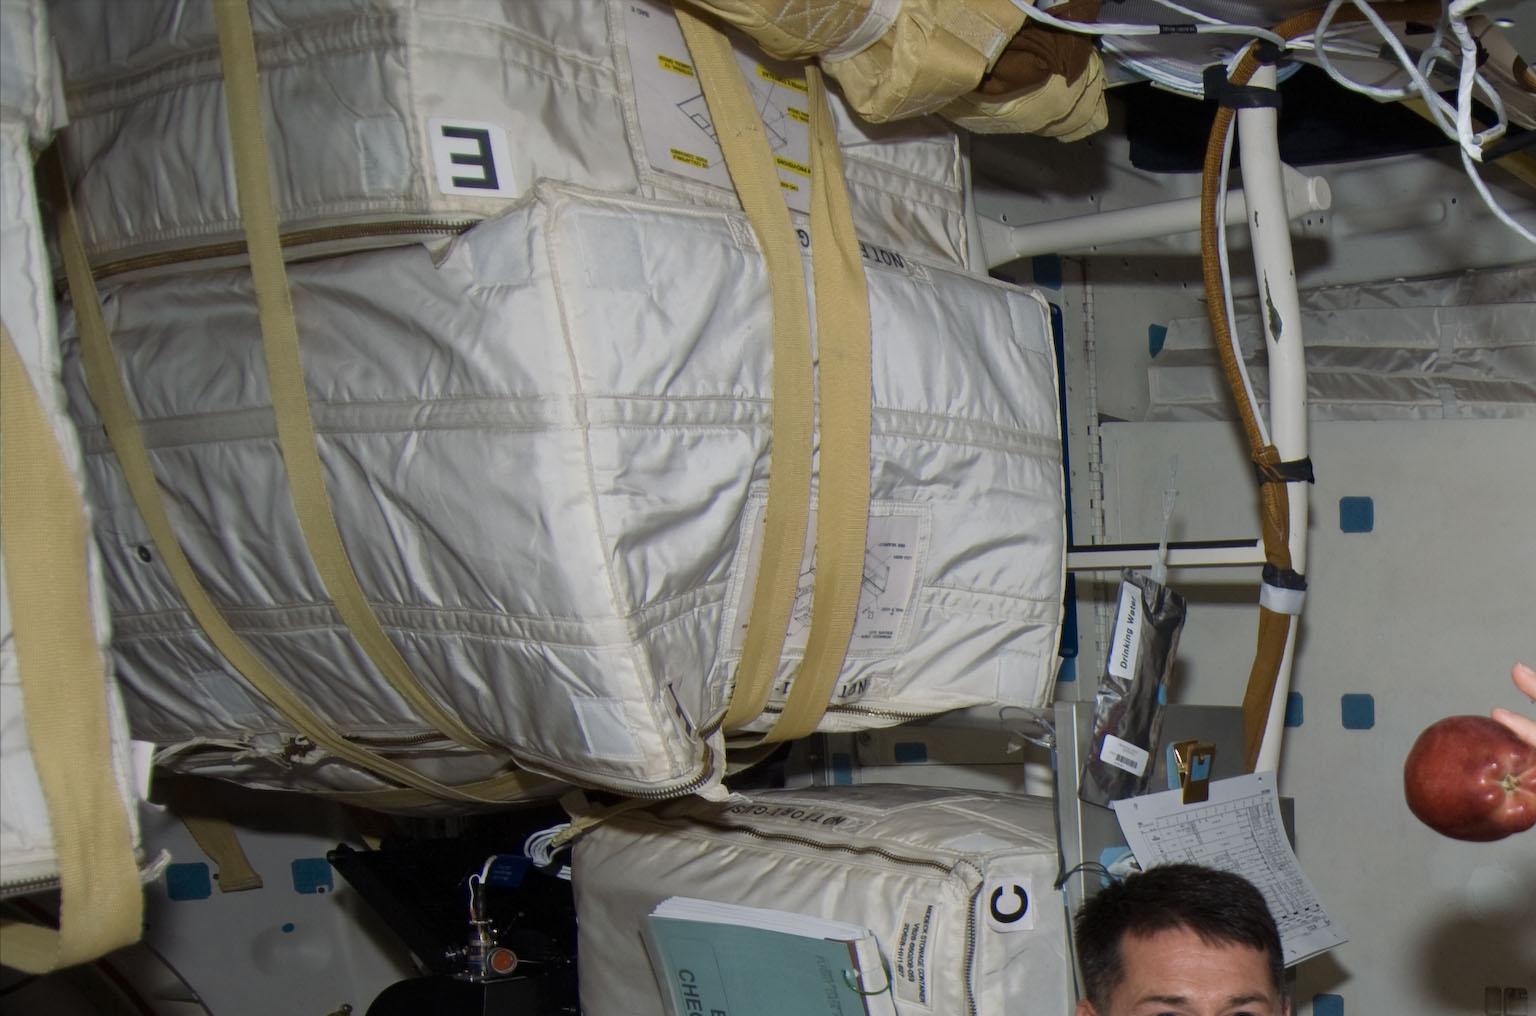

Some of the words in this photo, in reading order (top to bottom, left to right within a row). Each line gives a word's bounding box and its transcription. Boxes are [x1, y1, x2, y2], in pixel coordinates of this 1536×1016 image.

[441, 125, 500, 191] E
[1126, 595, 1138, 618] Water
[1119, 622, 1134, 670] Drinking
[990, 884, 1028, 923] C
